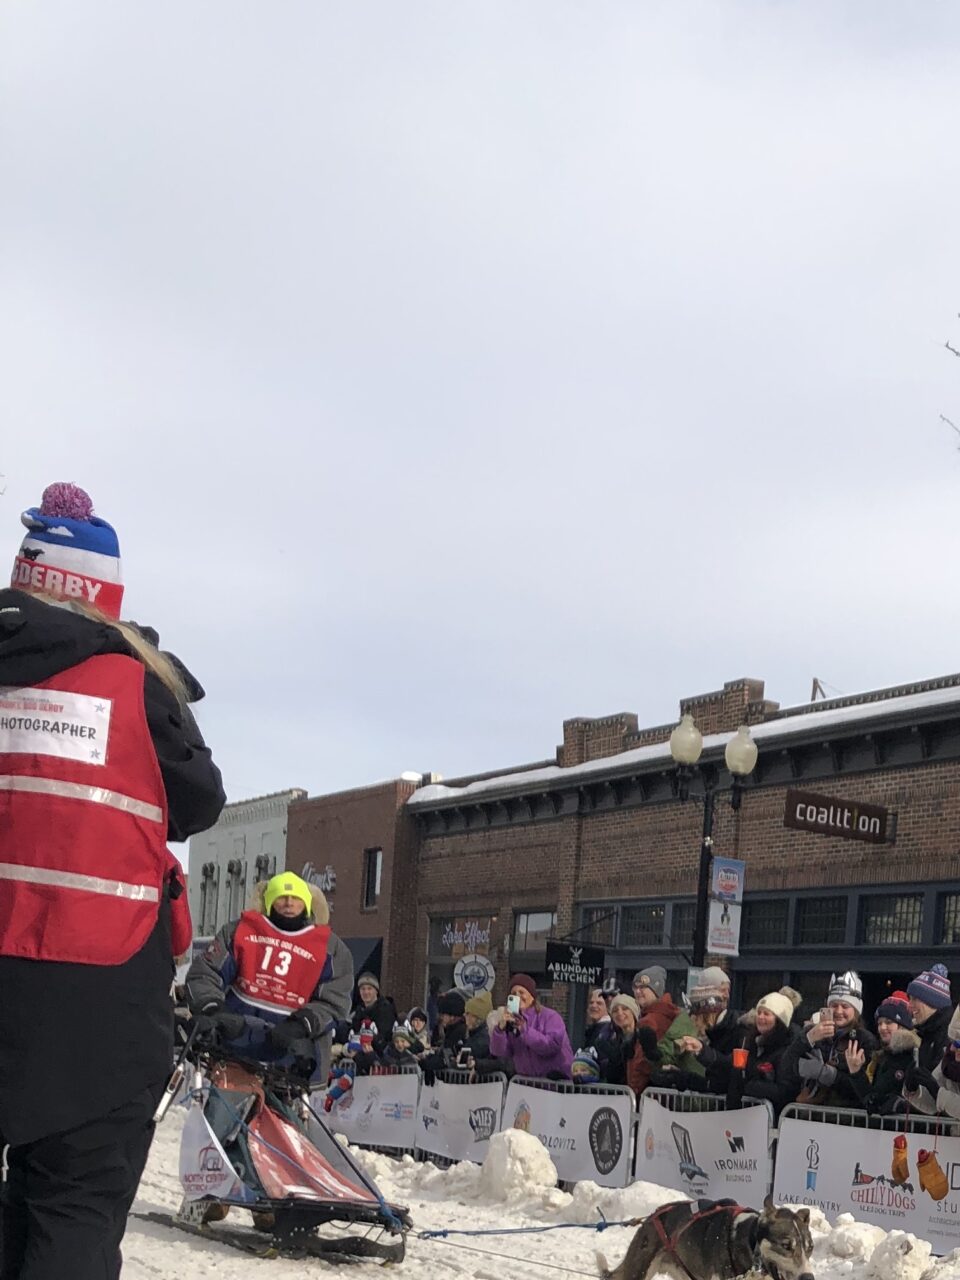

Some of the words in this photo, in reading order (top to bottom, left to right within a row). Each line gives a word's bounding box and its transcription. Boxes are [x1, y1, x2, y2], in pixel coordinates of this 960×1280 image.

[0, 717, 97, 740] HOTOGRAPHER
[261, 946, 292, 976] 13
[547, 962, 601, 976] ABUNDANT
[553, 971, 596, 985] KITCHEN
[538, 1133, 576, 1151] OLOVITZ
[714, 1159, 758, 1171] IRONMARK
[850, 1185, 887, 1206] CHILLY
[887, 1188, 916, 1210] DOGS
